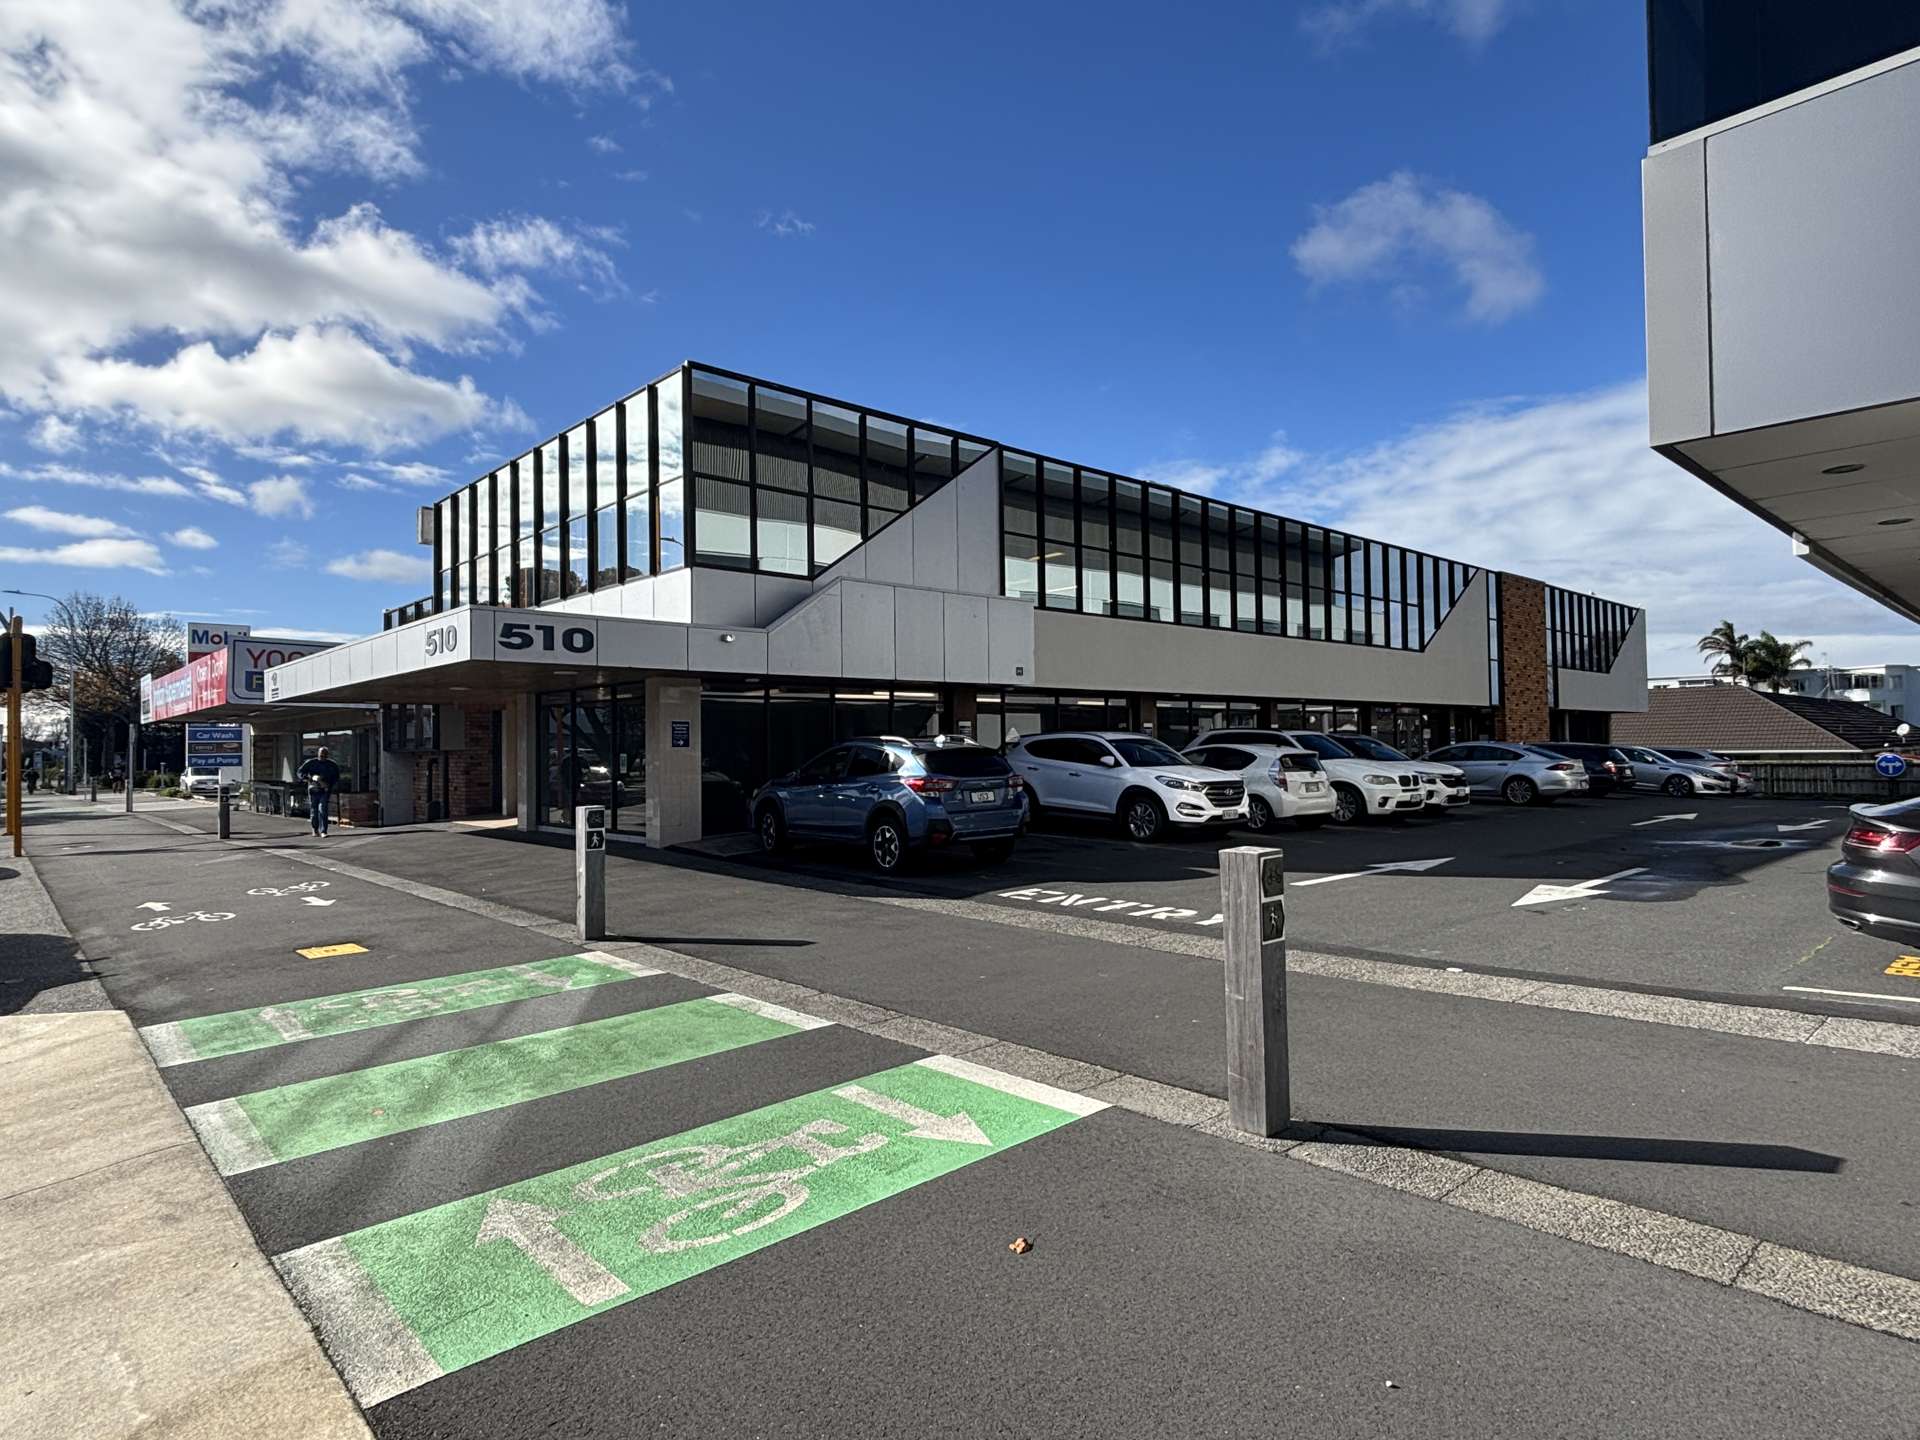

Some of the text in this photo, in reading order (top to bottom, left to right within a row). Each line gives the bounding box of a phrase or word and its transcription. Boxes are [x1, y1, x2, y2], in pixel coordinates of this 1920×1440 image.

[425, 625, 457, 656] 510
[498, 623, 594, 653] 510
[211, 731, 234, 739] Wash
[191, 757, 206, 766] Pay
[216, 757, 240, 765] Pump
